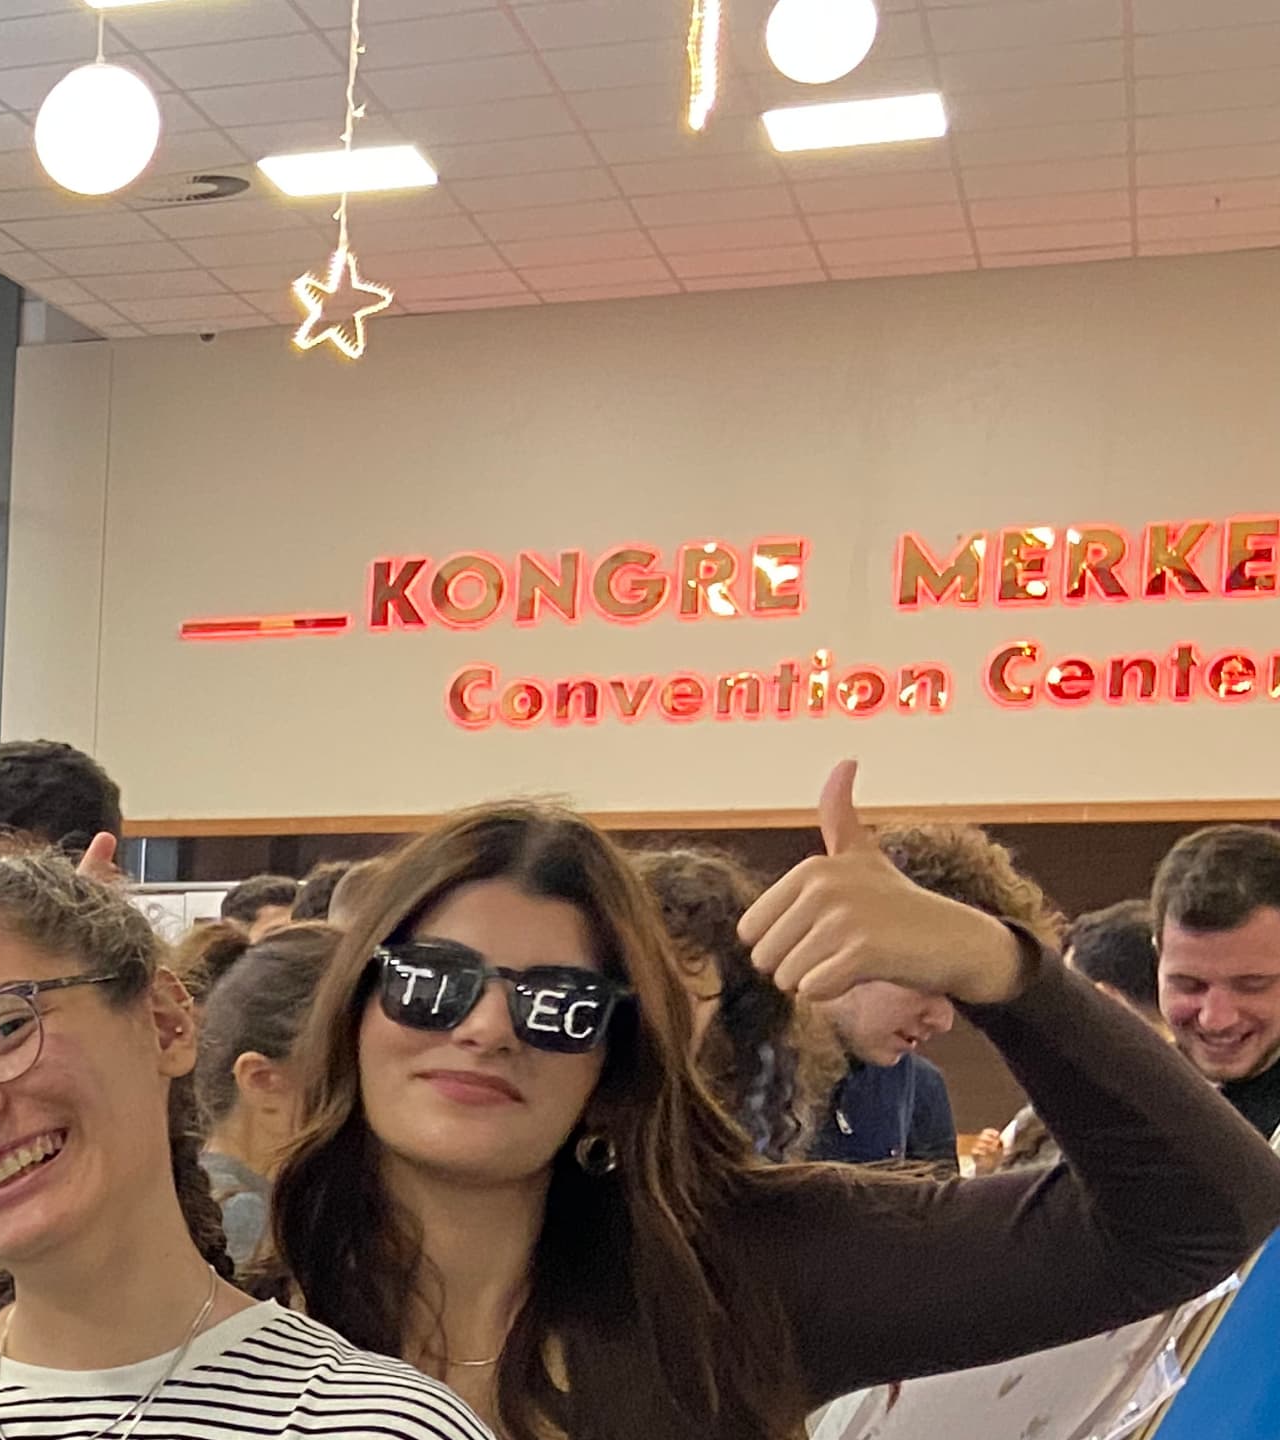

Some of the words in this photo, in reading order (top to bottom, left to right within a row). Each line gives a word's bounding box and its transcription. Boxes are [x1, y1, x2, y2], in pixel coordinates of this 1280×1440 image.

[368, 538, 806, 628] KONGRE
[896, 516, 1280, 606] MERKE
[446, 647, 949, 724] Convention
